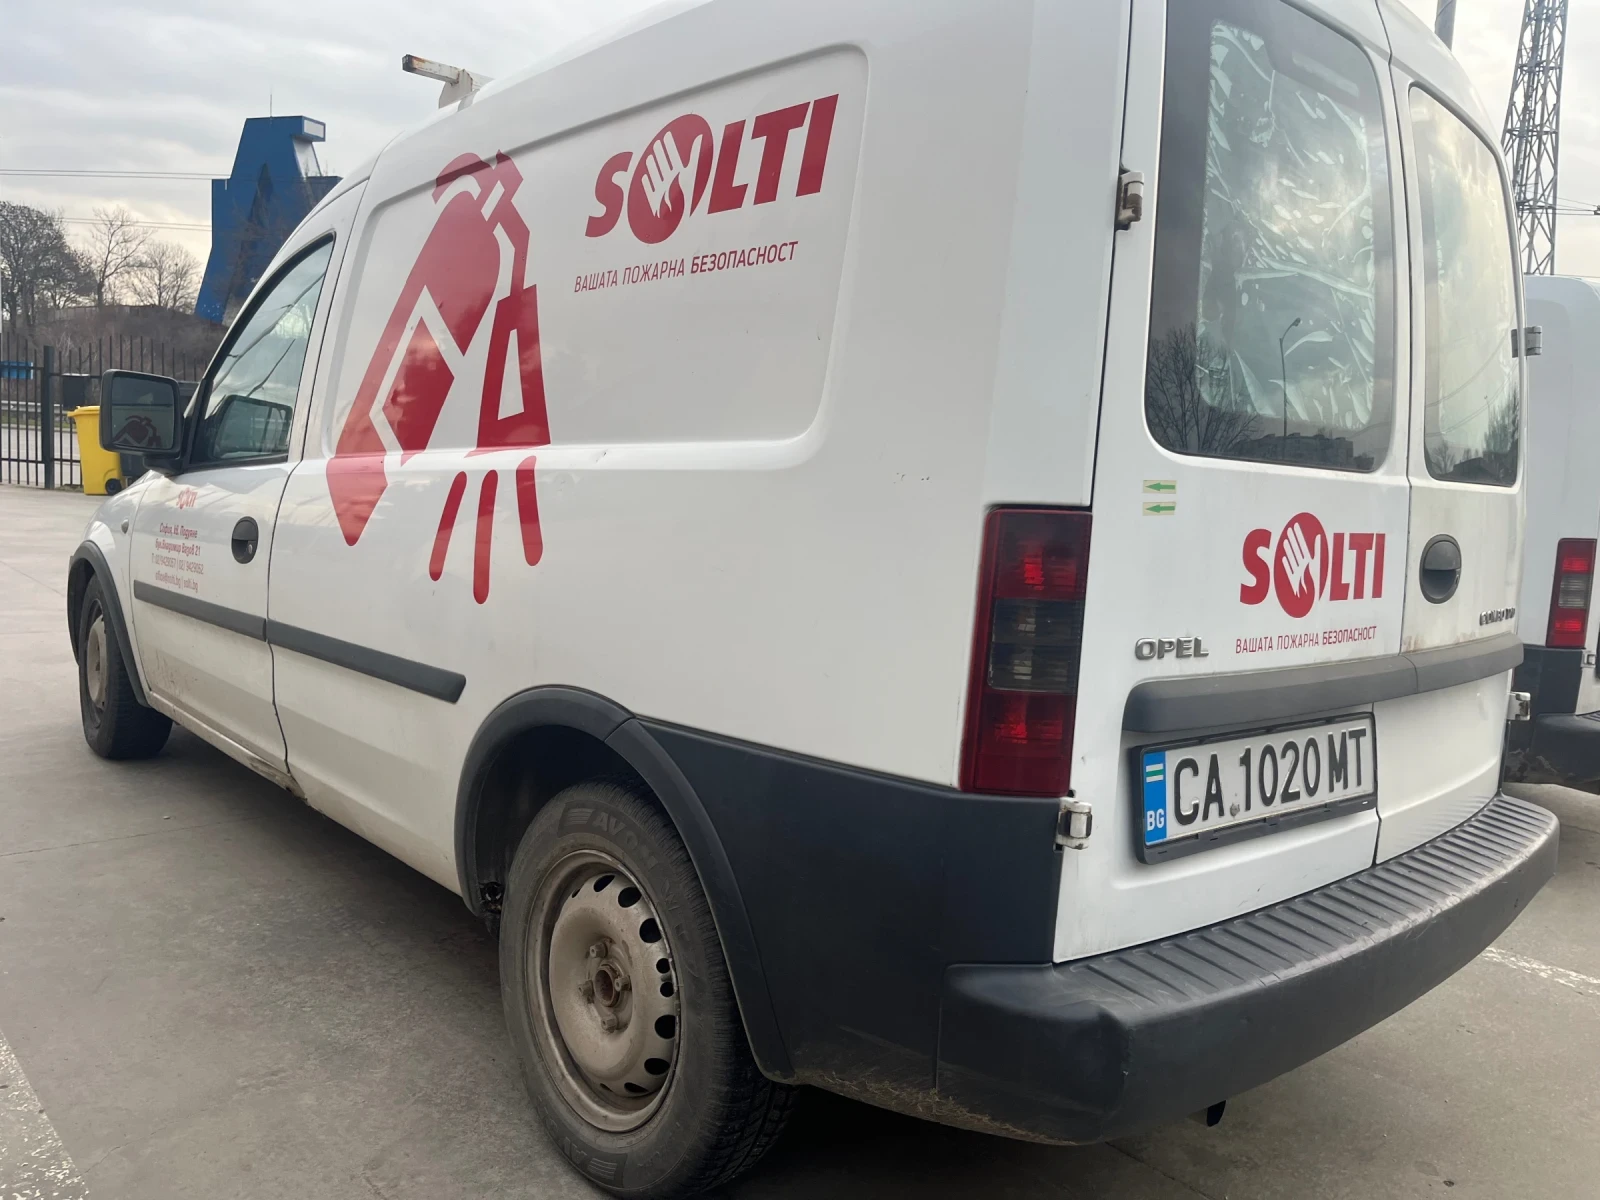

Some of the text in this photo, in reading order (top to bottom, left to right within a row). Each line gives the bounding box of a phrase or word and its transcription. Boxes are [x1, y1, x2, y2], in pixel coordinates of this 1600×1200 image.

[585, 94, 839, 244] SOLTI
[574, 241, 799, 293] ВАШАТА ПОЖАРНА БЕЗОПАСНОСТ
[1240, 512, 1386, 618] SOLTI
[1134, 636, 1209, 661] OPEL
[1235, 626, 1378, 655] ВАШАТА ПОЖАРНА БЕЗОПАСНОСТ
[1146, 808, 1166, 832] BG
